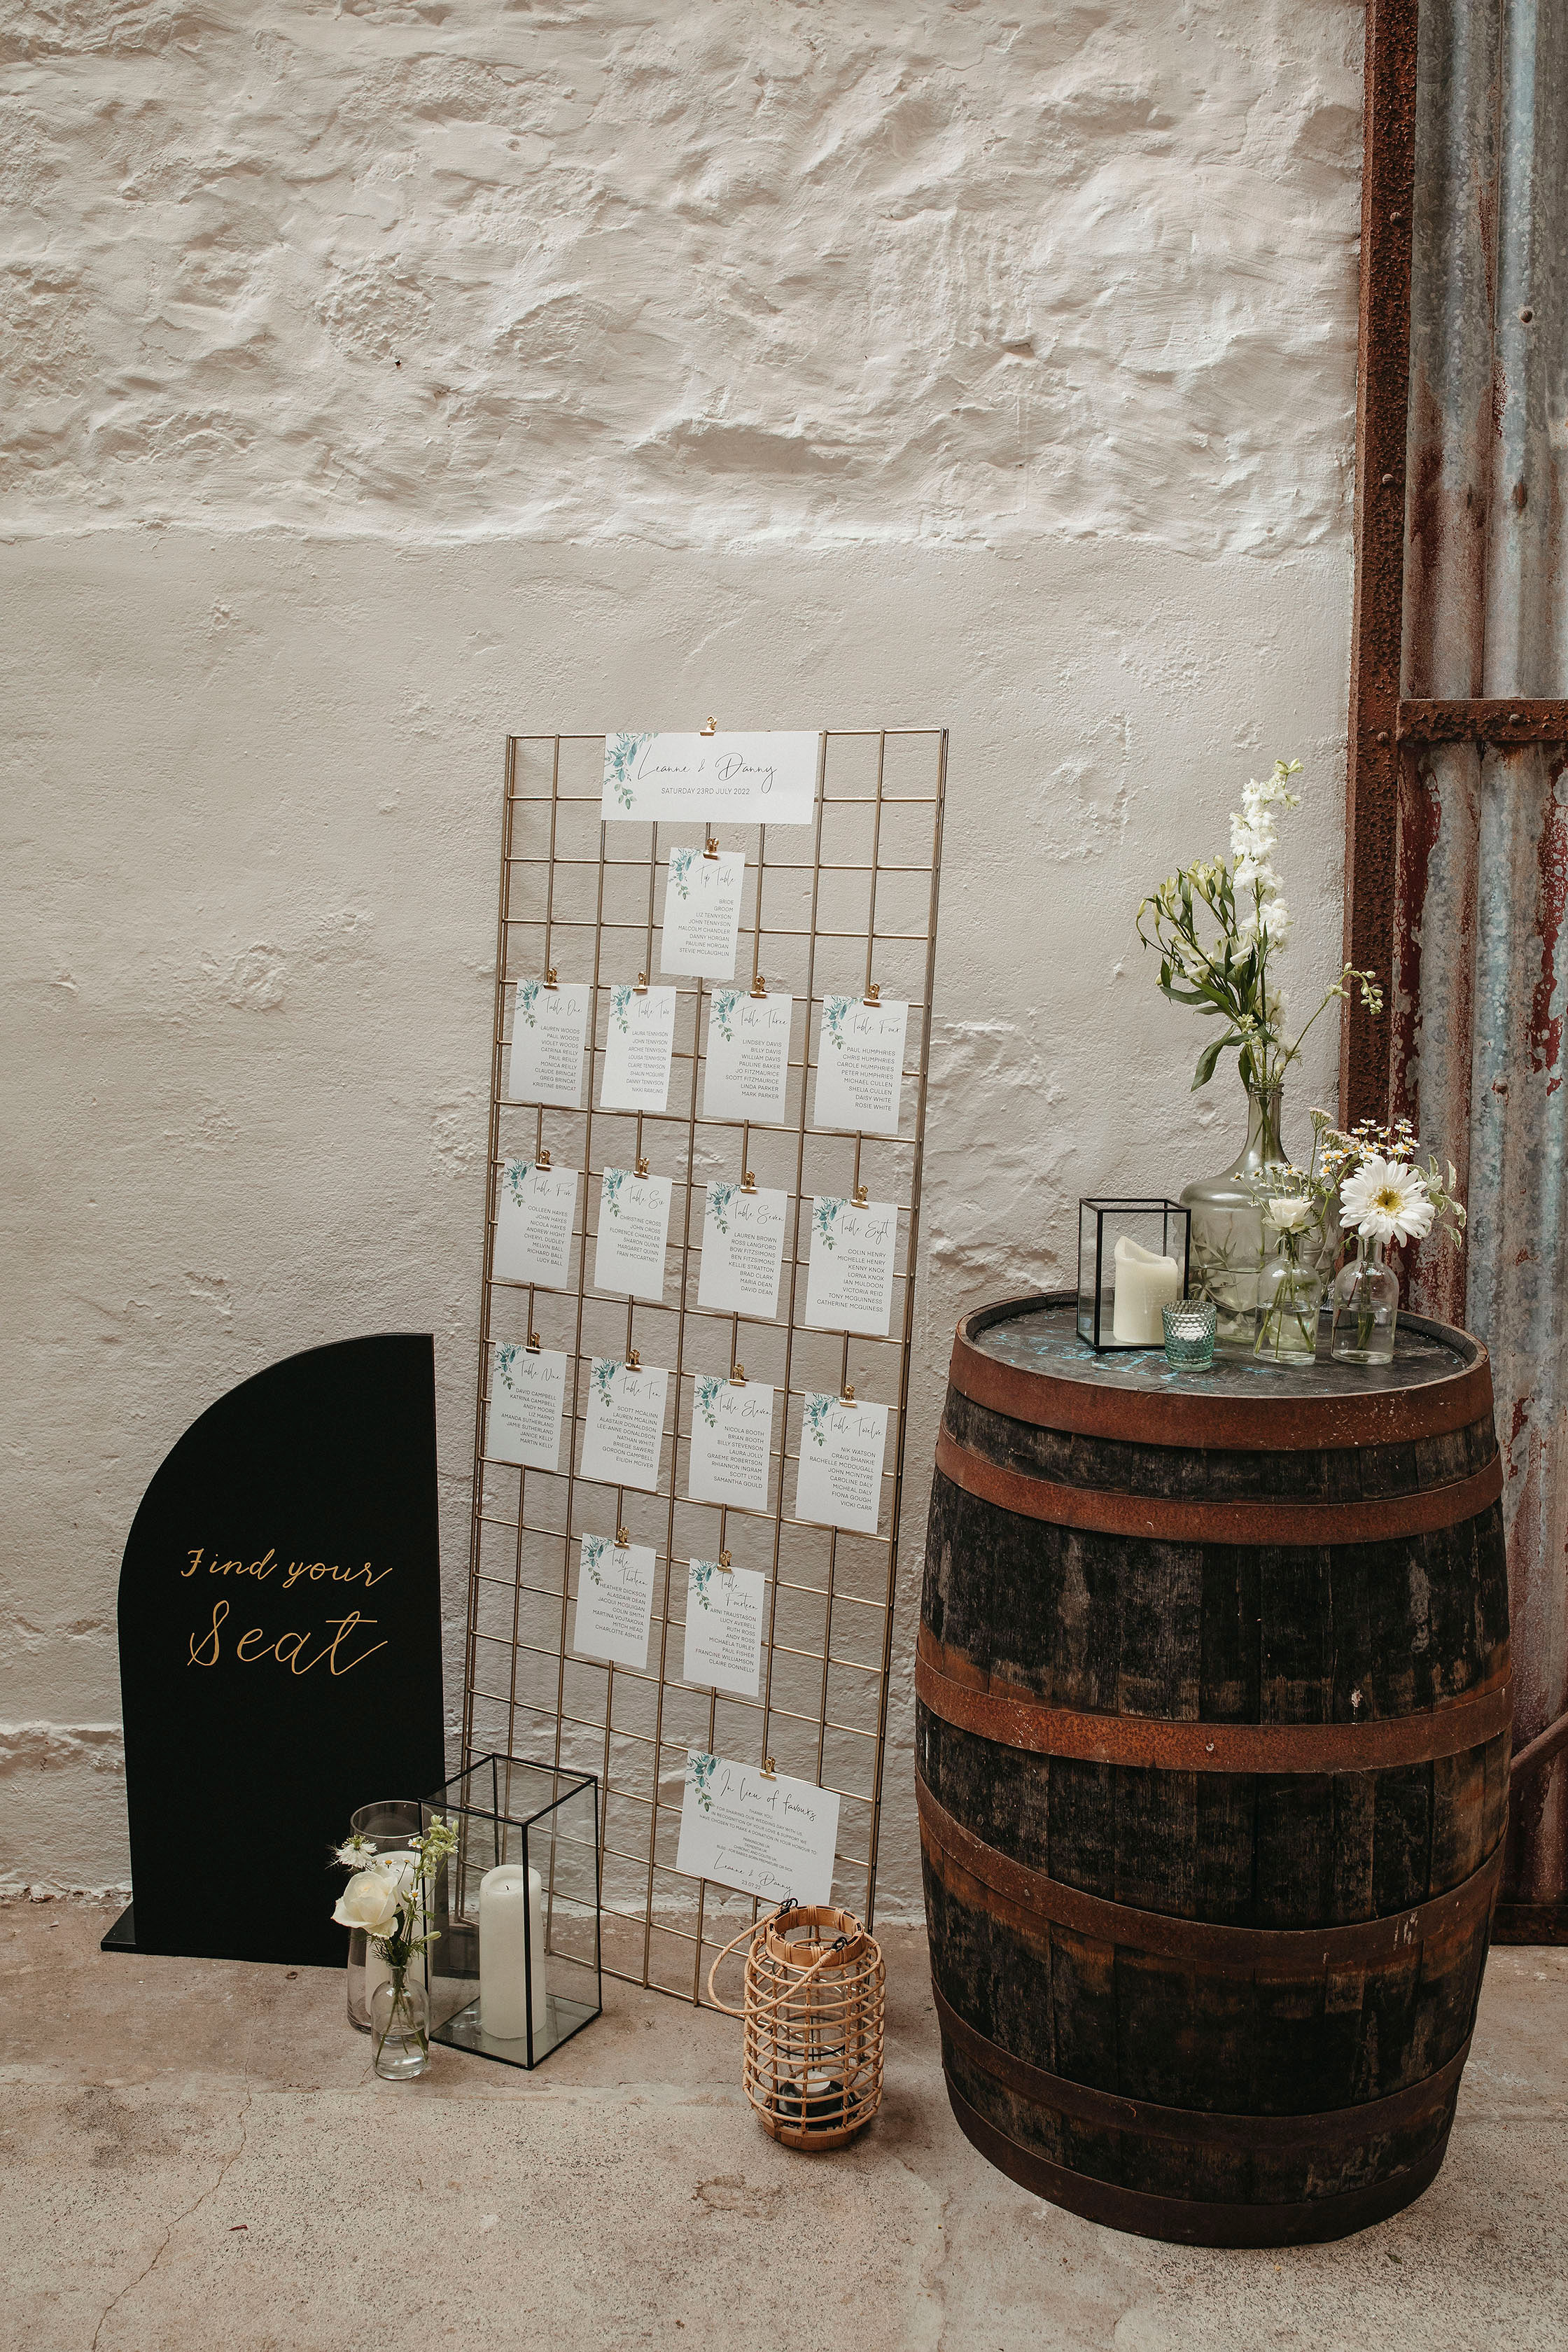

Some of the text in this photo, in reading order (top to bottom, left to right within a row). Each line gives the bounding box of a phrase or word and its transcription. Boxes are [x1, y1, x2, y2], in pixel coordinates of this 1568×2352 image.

[638, 744, 778, 794] Leanne & Danny
[695, 864, 734, 888] Top Table
[542, 995, 582, 1016] Table One
[634, 997, 670, 1019] Table Two
[736, 1006, 788, 1028] Table Three
[848, 1013, 901, 1035] Table Four
[528, 1175, 574, 1197] Table Five
[625, 1184, 664, 1210] Table Six
[528, 1205, 551, 1214] COLLEEN
[620, 1215, 644, 1224] CHRISTINE
[729, 1199, 784, 1224] Table Seven
[610, 1228, 660, 1241] FLORENCE CHANDLER
[836, 1214, 894, 1245] Table Eight
[630, 1254, 658, 1263] MCCARTNEY
[516, 1359, 561, 1381] Table Nine
[531, 1392, 556, 1400] CAMPBELL
[618, 1376, 661, 1399] Table Ten
[714, 1393, 771, 1418] Table Eleven
[501, 1413, 554, 1428] AMANDA SUTHERLAND
[599, 1417, 657, 1433] ALASTAIR DONALDSON
[825, 1412, 883, 1439] Table Twelve
[617, 1435, 638, 1443] NATHAN
[850, 1457, 874, 1465] SHANKIE
[852, 1449, 876, 1457] WATSON
[714, 1476, 742, 1485] SAMANTHA
[181, 1548, 393, 1588] Find your
[607, 1548, 629, 1568] Table
[617, 1567, 648, 1587] Thirteen
[716, 1572, 739, 1592] Table
[600, 1583, 646, 1597] HEATHER DICKSON
[598, 1597, 645, 1611] JACQUI MCGUIGAN
[726, 1592, 757, 1611] Fourteen
[188, 1600, 388, 1675] Seat
[596, 1625, 643, 1640] CHARLOTTE ASHLEE
[709, 1637, 734, 1646] MICHAELA
[728, 1663, 755, 1673] DONNELLY
[720, 1769, 817, 1822] In lieu of favours
[714, 1851, 744, 1874] Leanne
[759, 1871, 793, 1900] Danny
